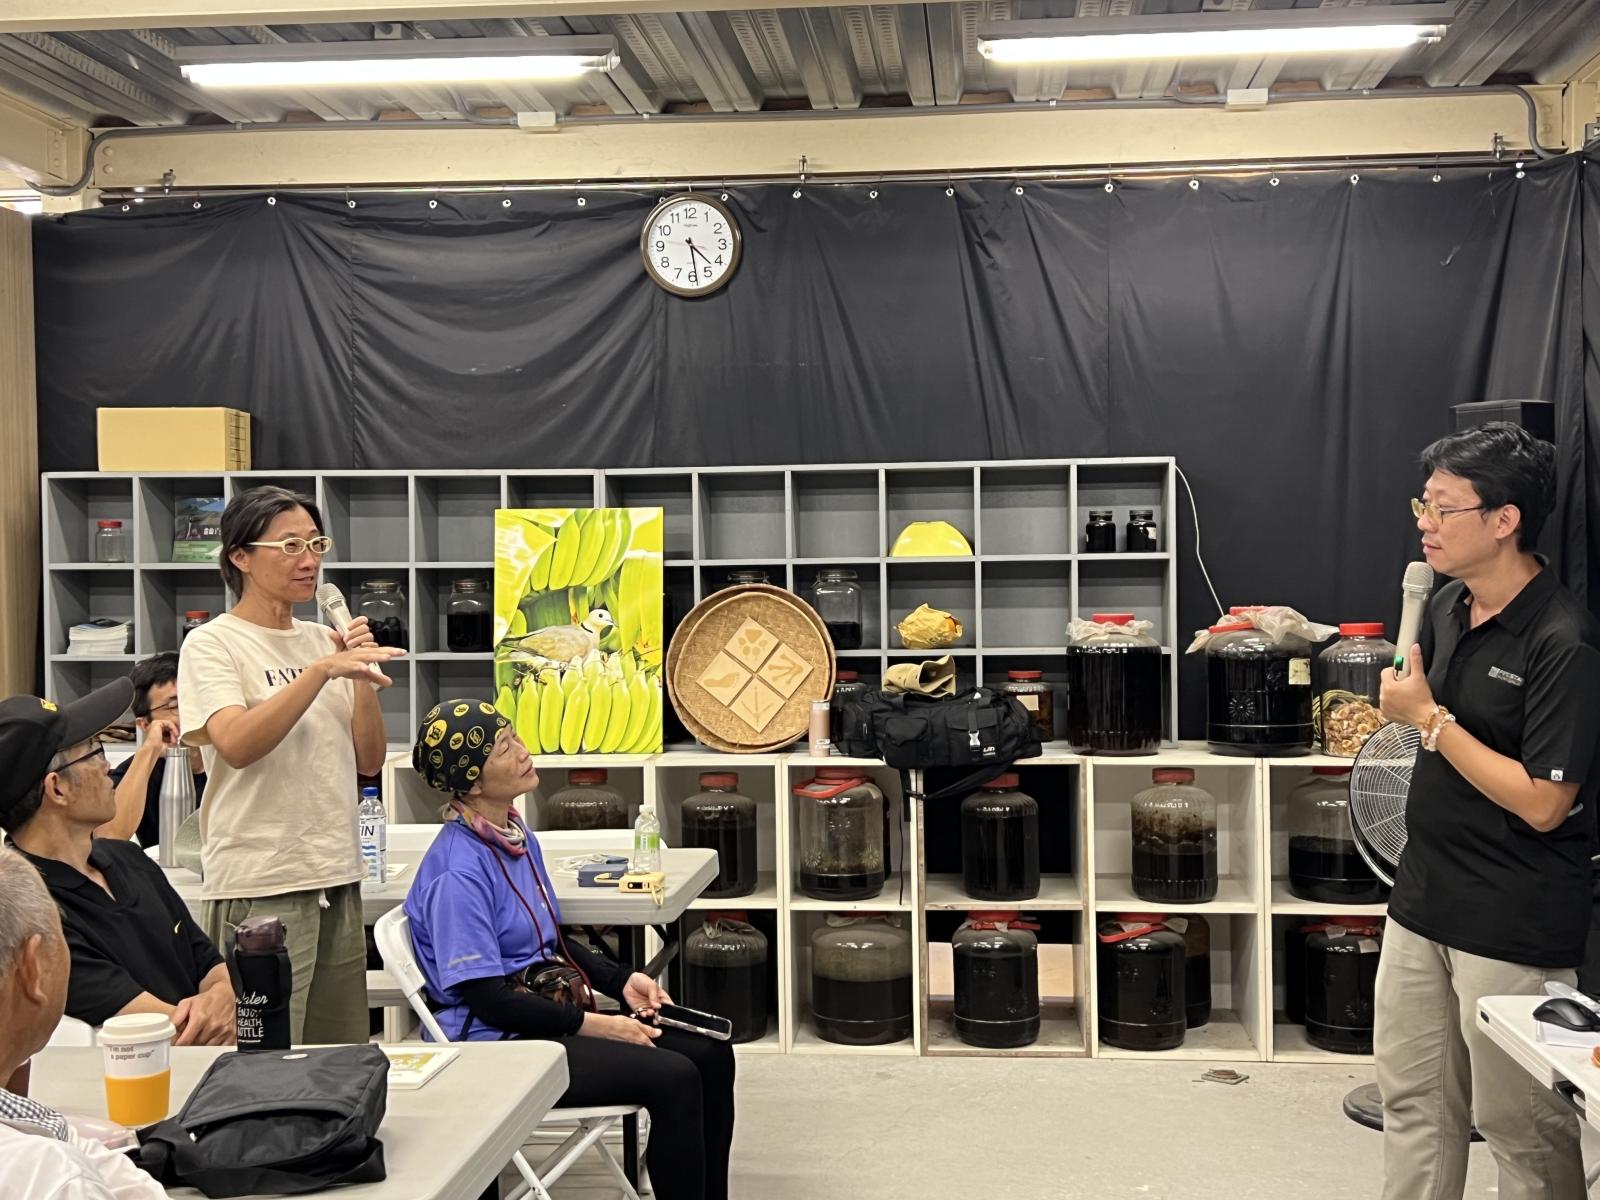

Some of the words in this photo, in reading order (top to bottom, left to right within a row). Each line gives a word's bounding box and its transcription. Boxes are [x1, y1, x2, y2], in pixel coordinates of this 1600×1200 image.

[670, 212, 680, 224] 11
[684, 207, 697, 219] 12
[704, 211, 709, 222] 1
[658, 225, 671, 236] 10
[713, 222, 722, 234] 2
[655, 240, 665, 252] 9
[718, 238, 727, 250] 3
[660, 256, 670, 268] 8
[714, 254, 723, 266] 4
[674, 267, 682, 279] 7
[688, 271, 697, 283] 6
[703, 266, 712, 278] 5
[264, 667, 303, 687] FAT
[360, 825, 375, 836] IN
